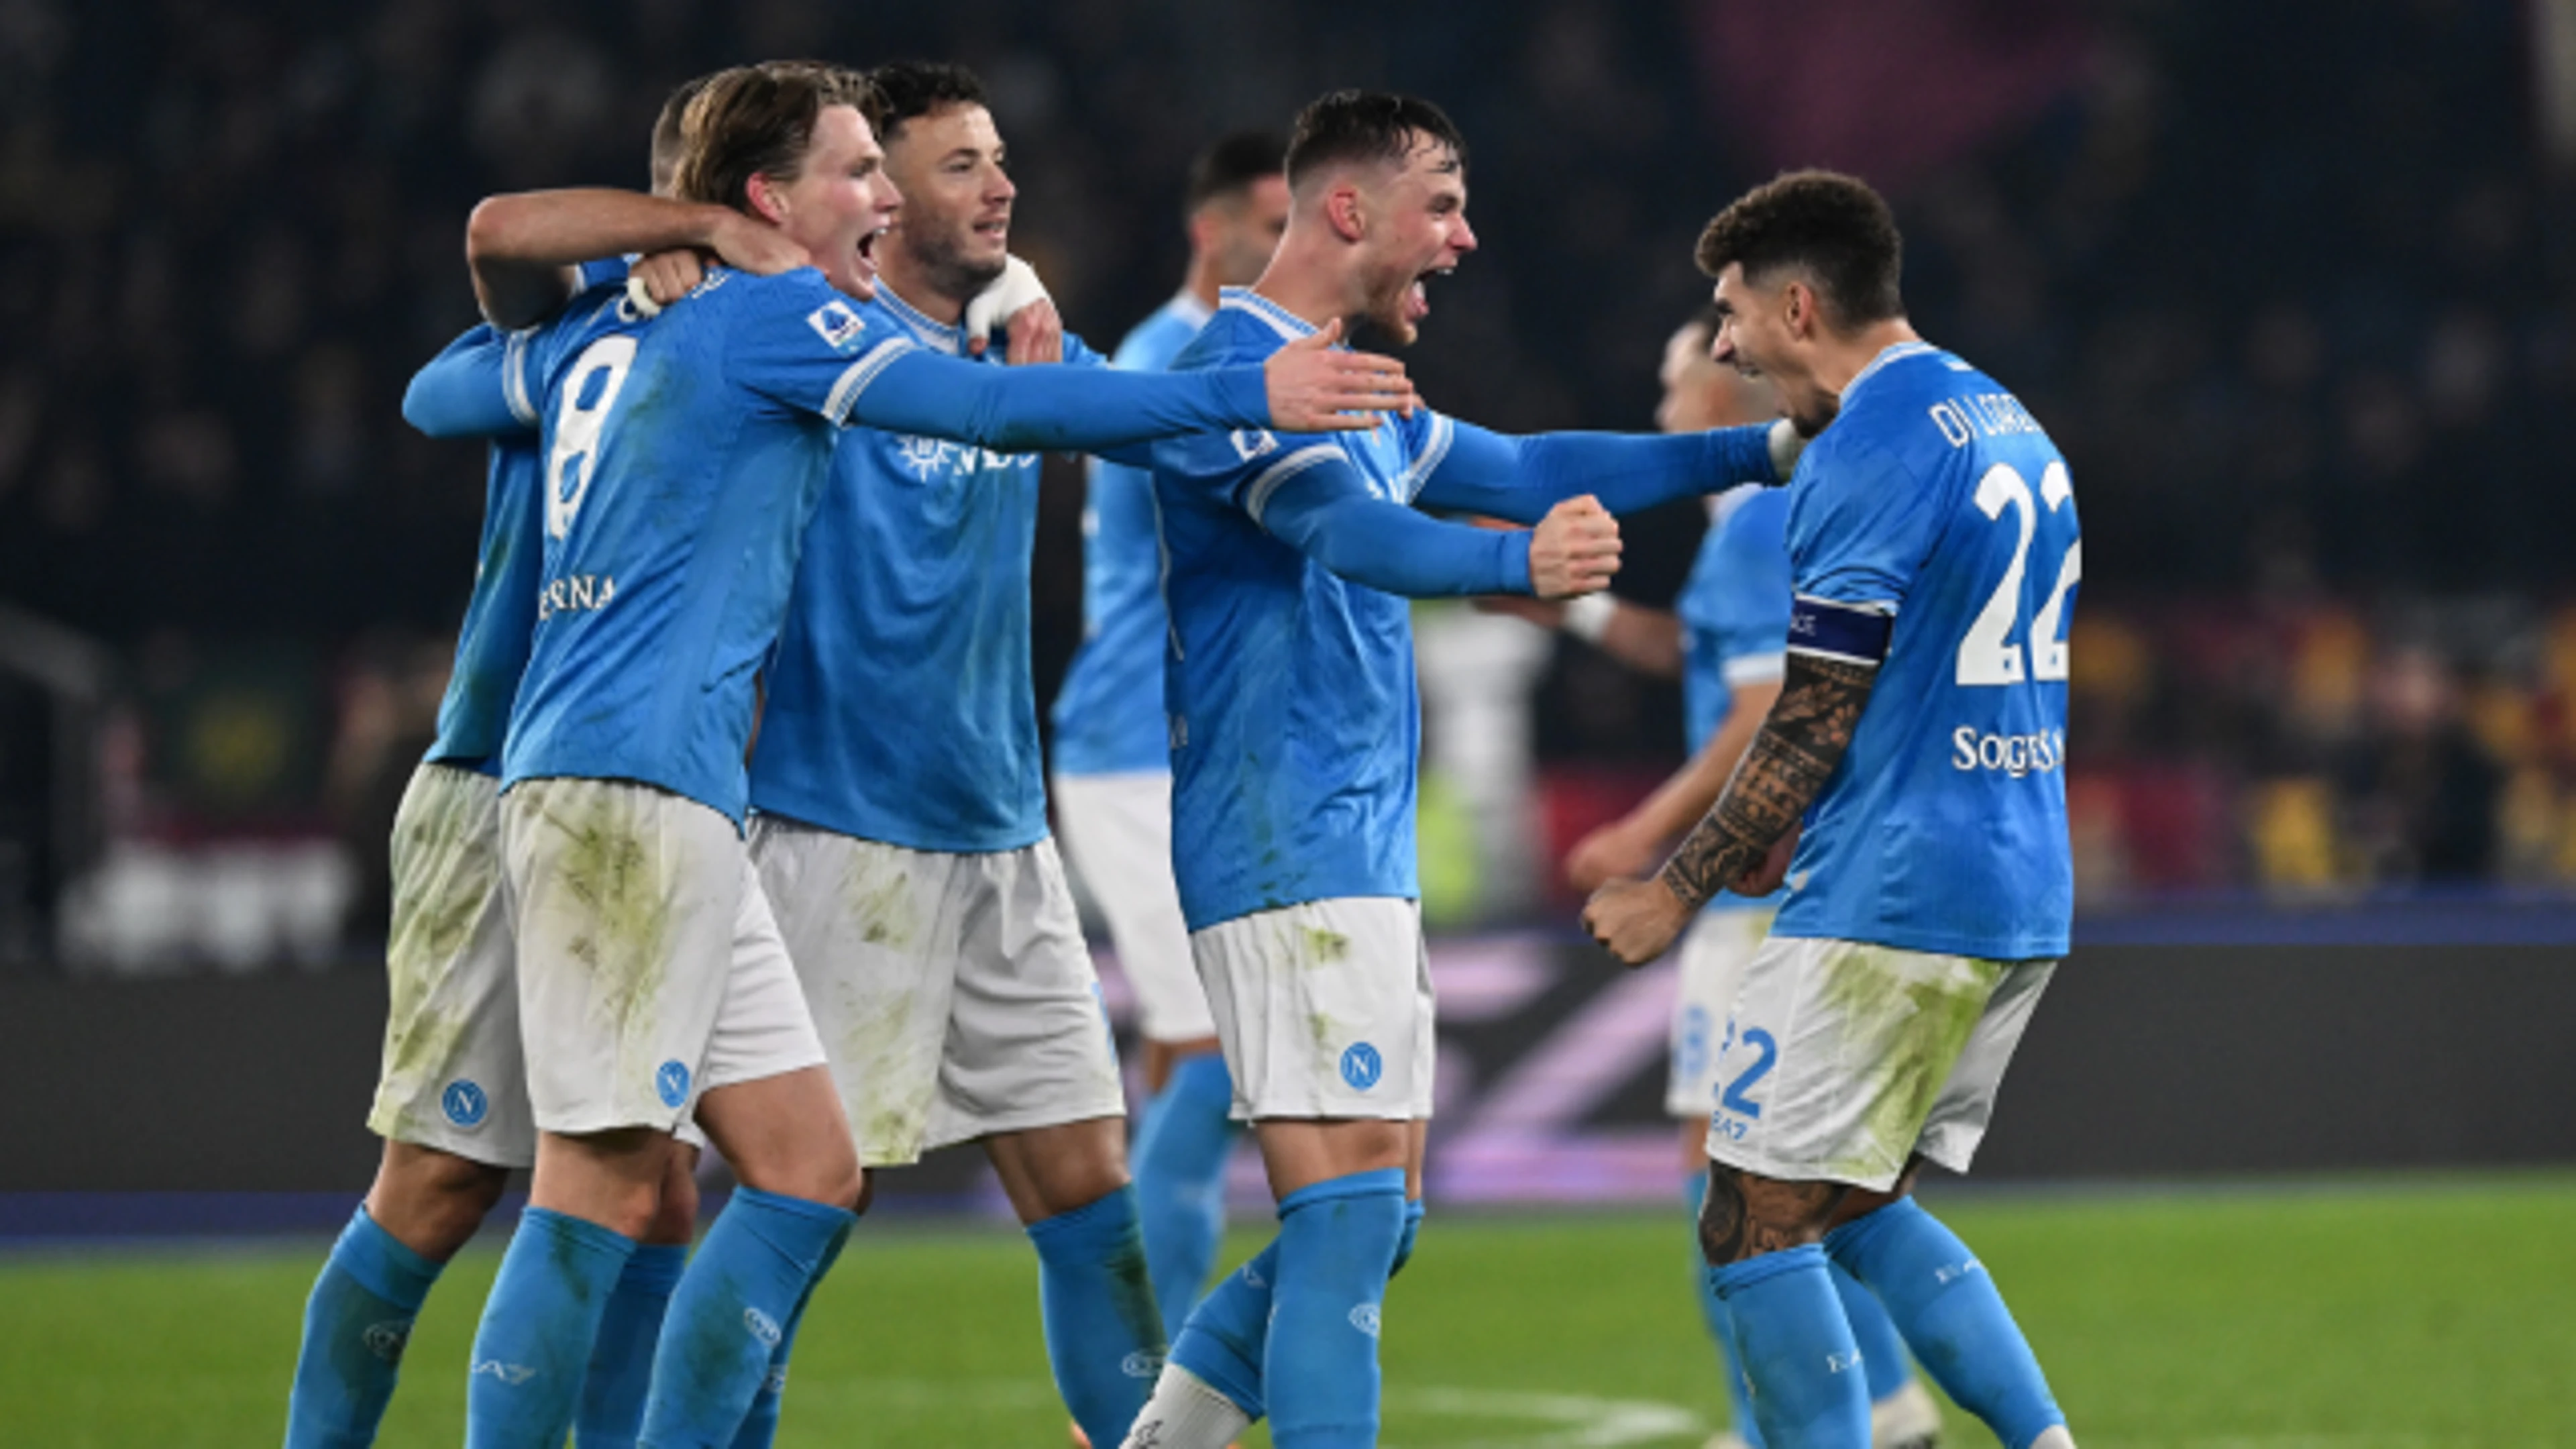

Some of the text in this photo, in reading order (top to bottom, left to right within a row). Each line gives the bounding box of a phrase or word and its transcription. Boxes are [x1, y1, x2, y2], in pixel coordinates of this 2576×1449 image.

[547, 333, 639, 541] 8
[1955, 463, 2082, 685] 22
[1713, 1019, 1778, 1120] 2
